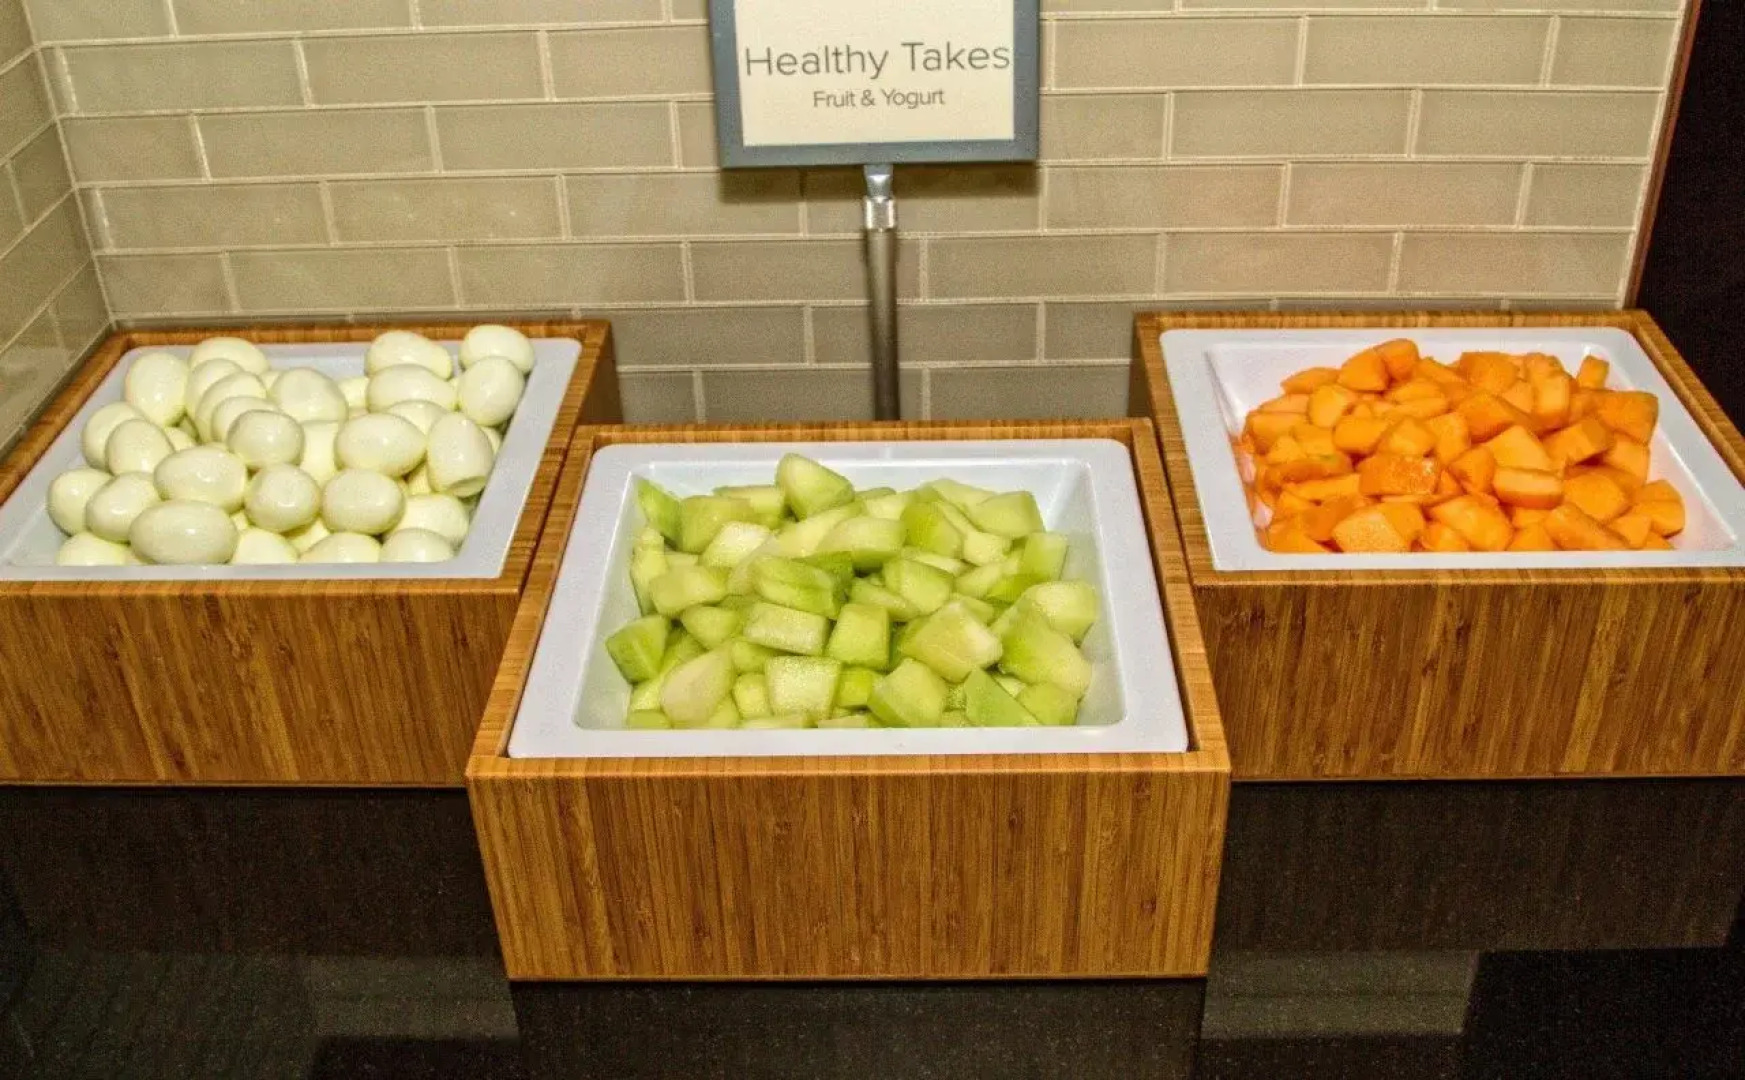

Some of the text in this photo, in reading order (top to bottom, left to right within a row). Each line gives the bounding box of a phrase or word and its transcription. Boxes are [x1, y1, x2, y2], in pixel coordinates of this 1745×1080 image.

[745, 41, 1011, 80] Healthy Takes
[813, 89, 945, 109] Fruit & Yogurt
